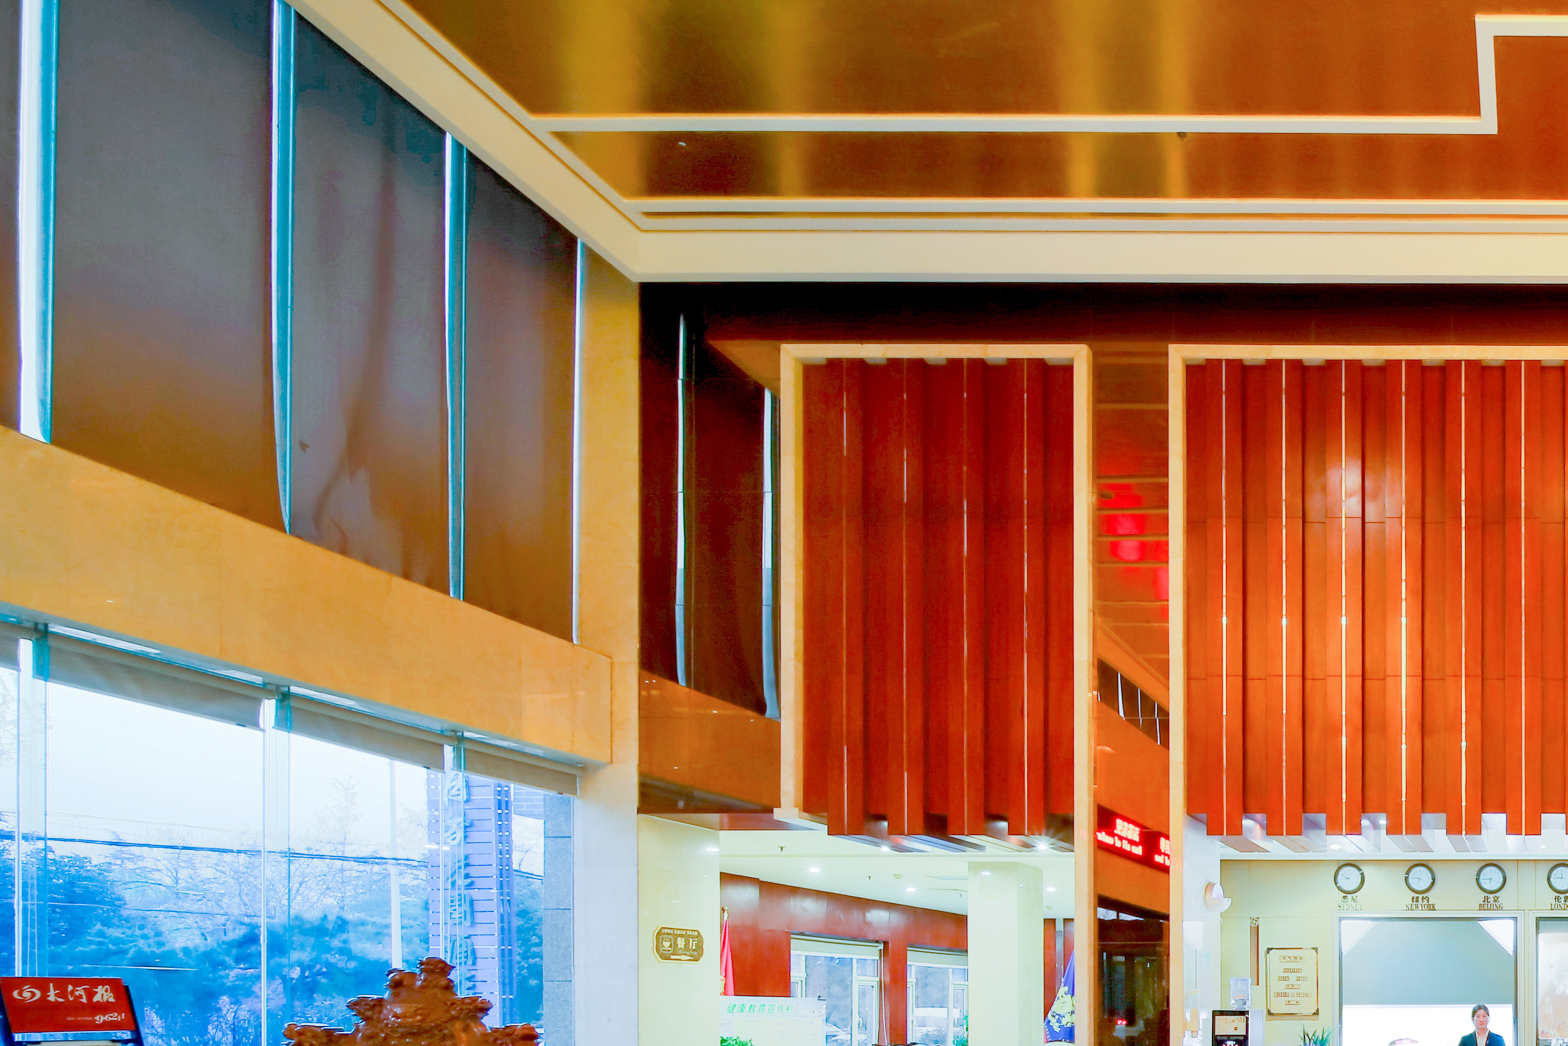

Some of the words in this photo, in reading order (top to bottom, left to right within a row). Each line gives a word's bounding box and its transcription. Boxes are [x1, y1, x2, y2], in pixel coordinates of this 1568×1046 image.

[1482, 895, 1500, 903] 北京
[1405, 903, 1420, 911] NEW
[1420, 903, 1436, 911] YORK
[1478, 903, 1503, 911] BEIJING
[676, 936, 698, 950] 餐厅
[46, 983, 115, 1003] 大河报
[94, 1012, 125, 1024] 96211
